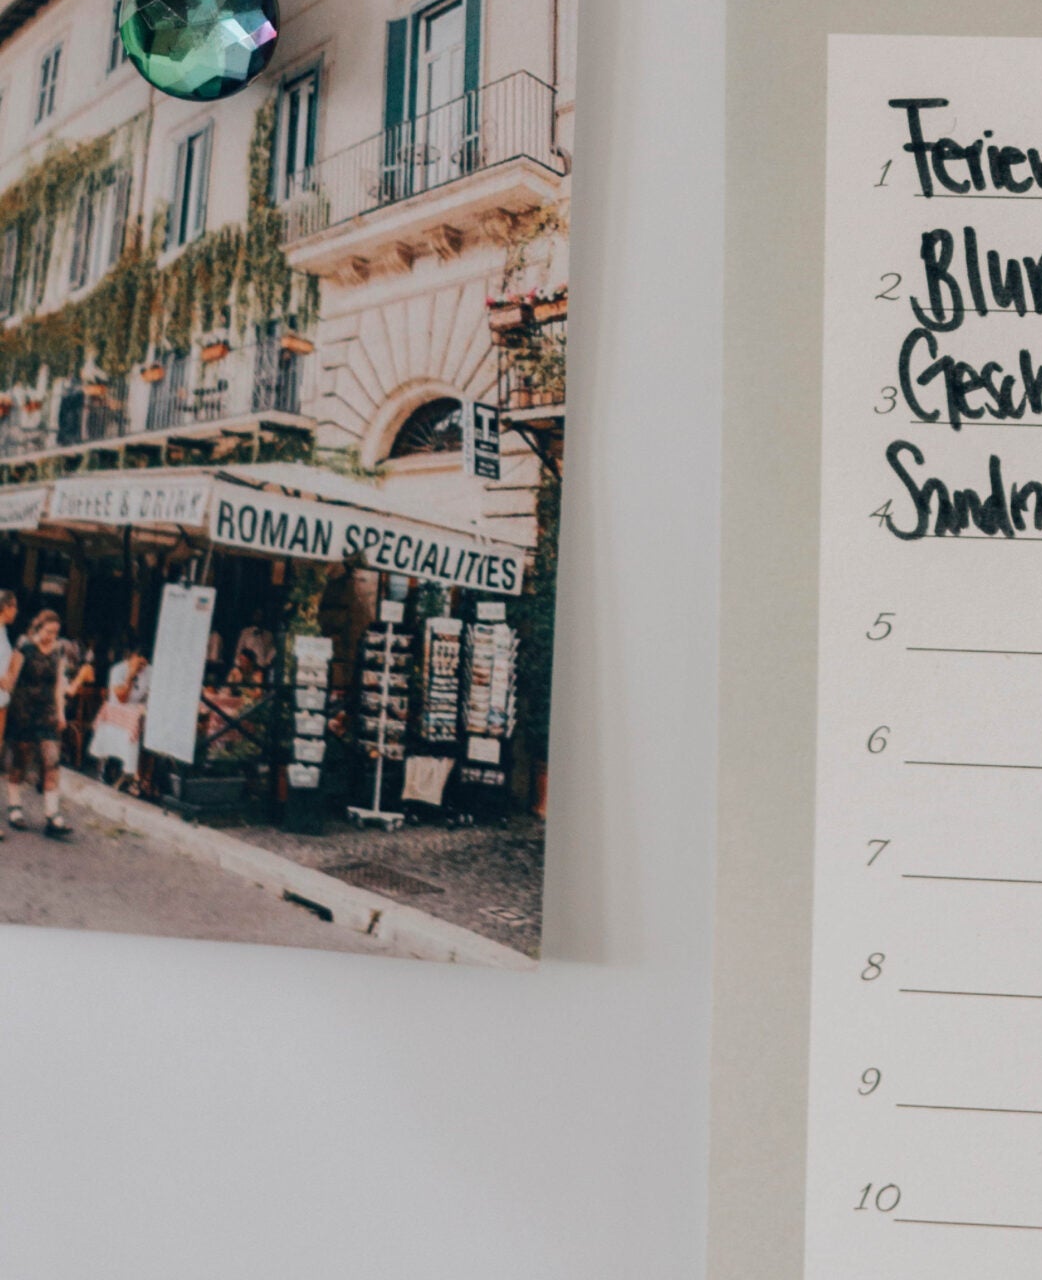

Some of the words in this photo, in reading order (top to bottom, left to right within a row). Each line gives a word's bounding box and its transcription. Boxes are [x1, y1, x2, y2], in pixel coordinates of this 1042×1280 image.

[873, 159, 893, 188] 1
[874, 272, 902, 301] 2
[873, 385, 898, 415] 3
[216, 499, 333, 556] ROMAN
[342, 523, 517, 591] SPECIALITIES
[865, 612, 896, 641] 5
[866, 725, 891, 754] 6
[866, 839, 891, 867] 7
[860, 952, 886, 982] 8
[857, 1067, 882, 1097] 9
[853, 1182, 902, 1213] 10
